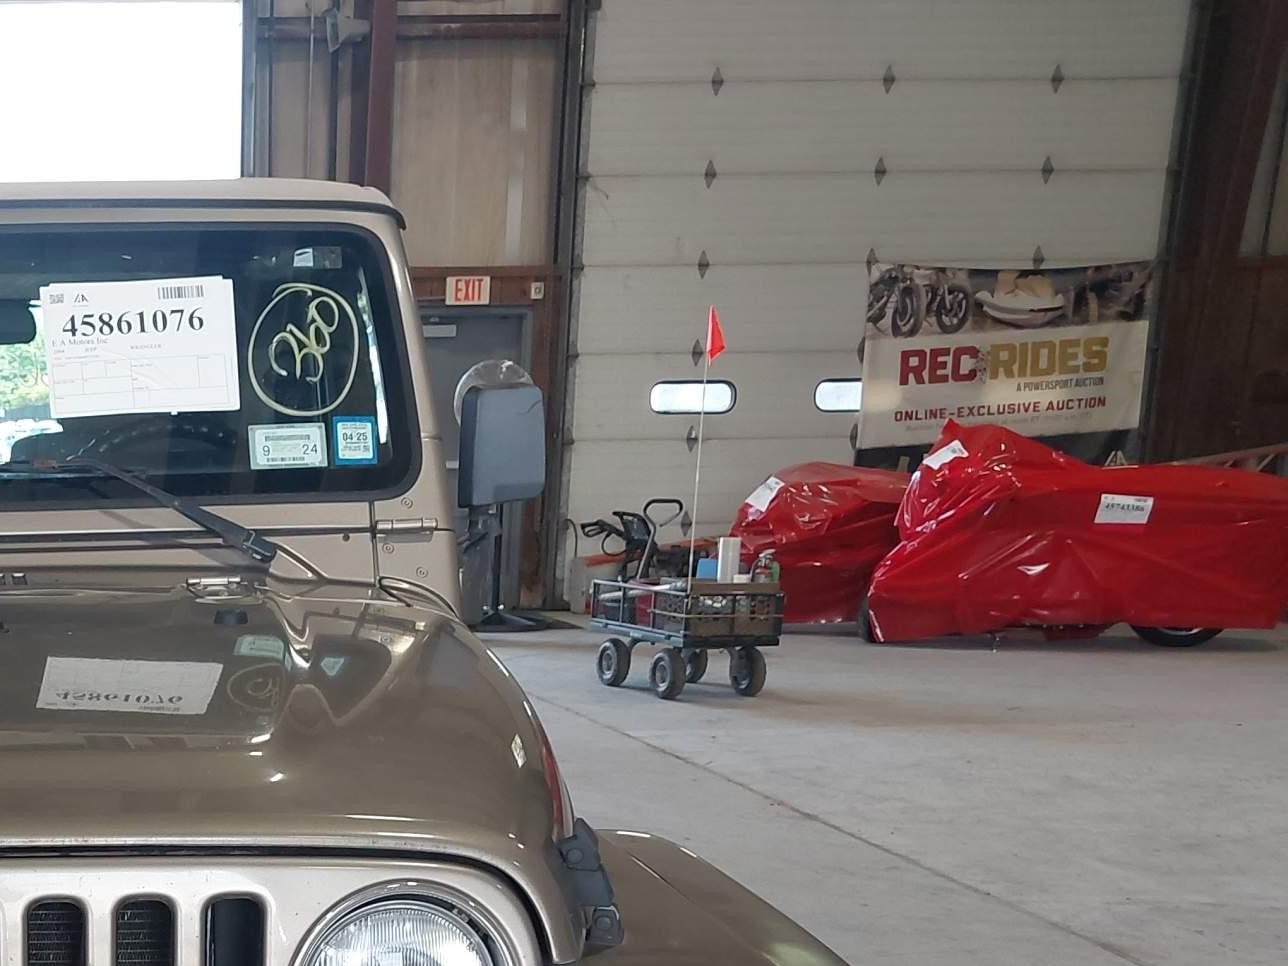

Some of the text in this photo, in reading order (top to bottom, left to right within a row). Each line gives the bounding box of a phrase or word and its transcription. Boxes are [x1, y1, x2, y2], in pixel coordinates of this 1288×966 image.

[454, 278, 484, 302] EXIT
[62, 307, 204, 337] 45861076
[899, 336, 1109, 386] REC RIDES
[1016, 376, 1104, 392] A POWERSPORT AUCTION
[894, 400, 1041, 422] ONLINE-EXCLUSIVE
[1045, 396, 1107, 412] AUCTION
[262, 444, 318, 456] 9 24
